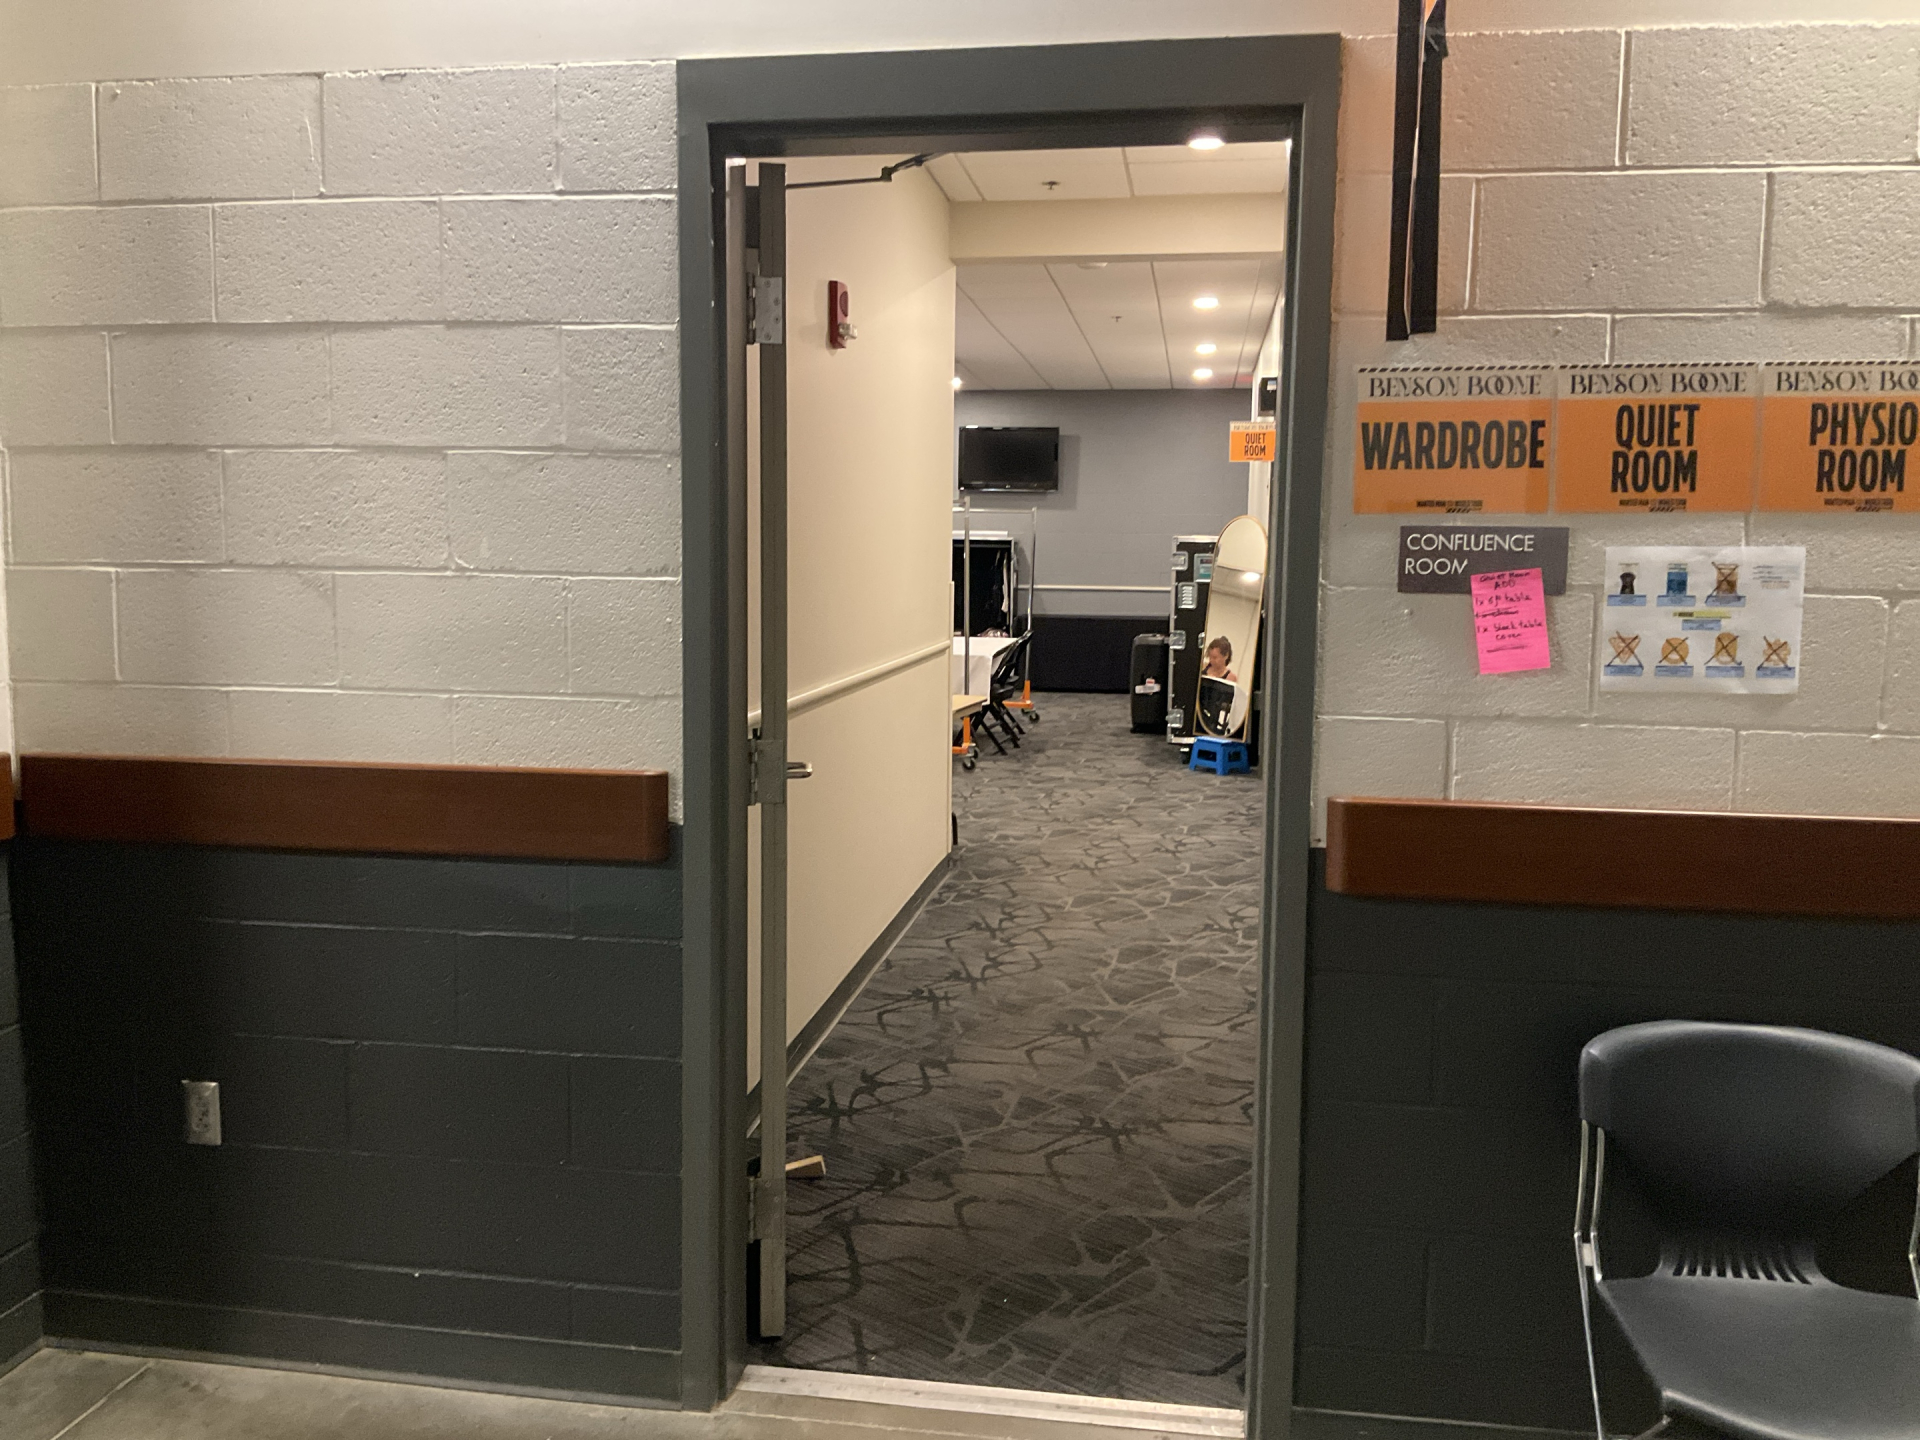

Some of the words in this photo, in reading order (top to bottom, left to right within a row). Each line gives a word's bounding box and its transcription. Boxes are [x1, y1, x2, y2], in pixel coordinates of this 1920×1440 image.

[1369, 376, 1460, 398] BENSON
[1467, 374, 1542, 396] BOONE
[1570, 373, 1663, 395] BENSON
[1671, 371, 1747, 393] BOONE
[1776, 370, 1873, 392] BENSON
[1879, 370, 1920, 391] BOO
[1616, 404, 1700, 451] QUIET
[1809, 402, 1919, 446] PHYSIO
[1244, 445, 1266, 456] ROOM
[1245, 433, 1266, 445] QUIET
[1361, 420, 1546, 470] WARDROBE
[1610, 450, 1698, 493] ROOM
[1816, 449, 1907, 492] ROOM
[1406, 534, 1535, 551] CONFLUENCE
[1504, 592, 1532, 602] table
[1518, 618, 1543, 628] table
